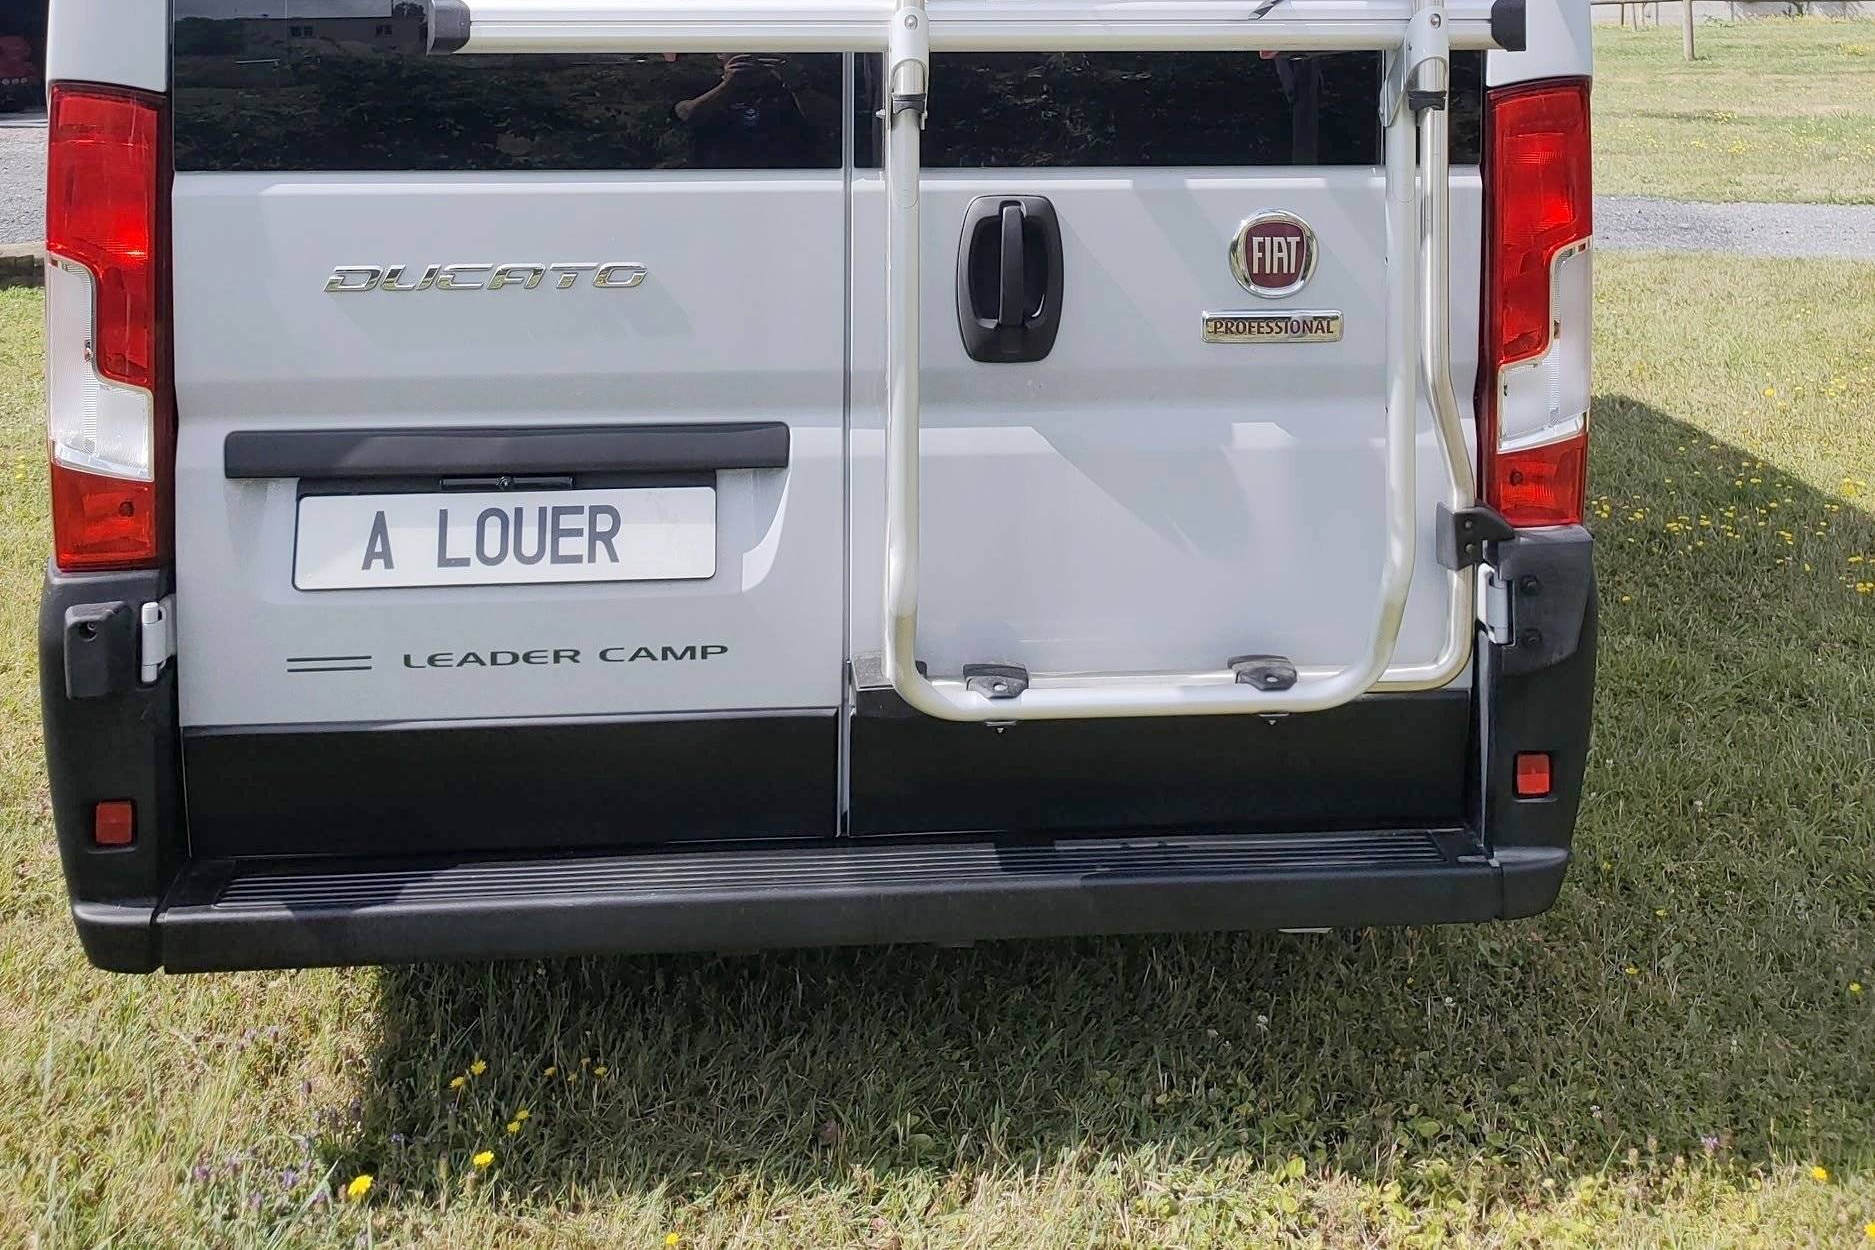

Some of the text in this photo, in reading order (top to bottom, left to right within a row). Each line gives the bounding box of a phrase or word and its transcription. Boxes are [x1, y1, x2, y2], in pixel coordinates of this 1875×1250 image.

[1252, 236, 1300, 274] FIAT
[323, 261, 649, 293] DUCATO
[1213, 319, 1334, 336] PROFESSIONAL
[361, 504, 622, 570] A LOUER
[403, 644, 729, 669] LEADER CAMP
